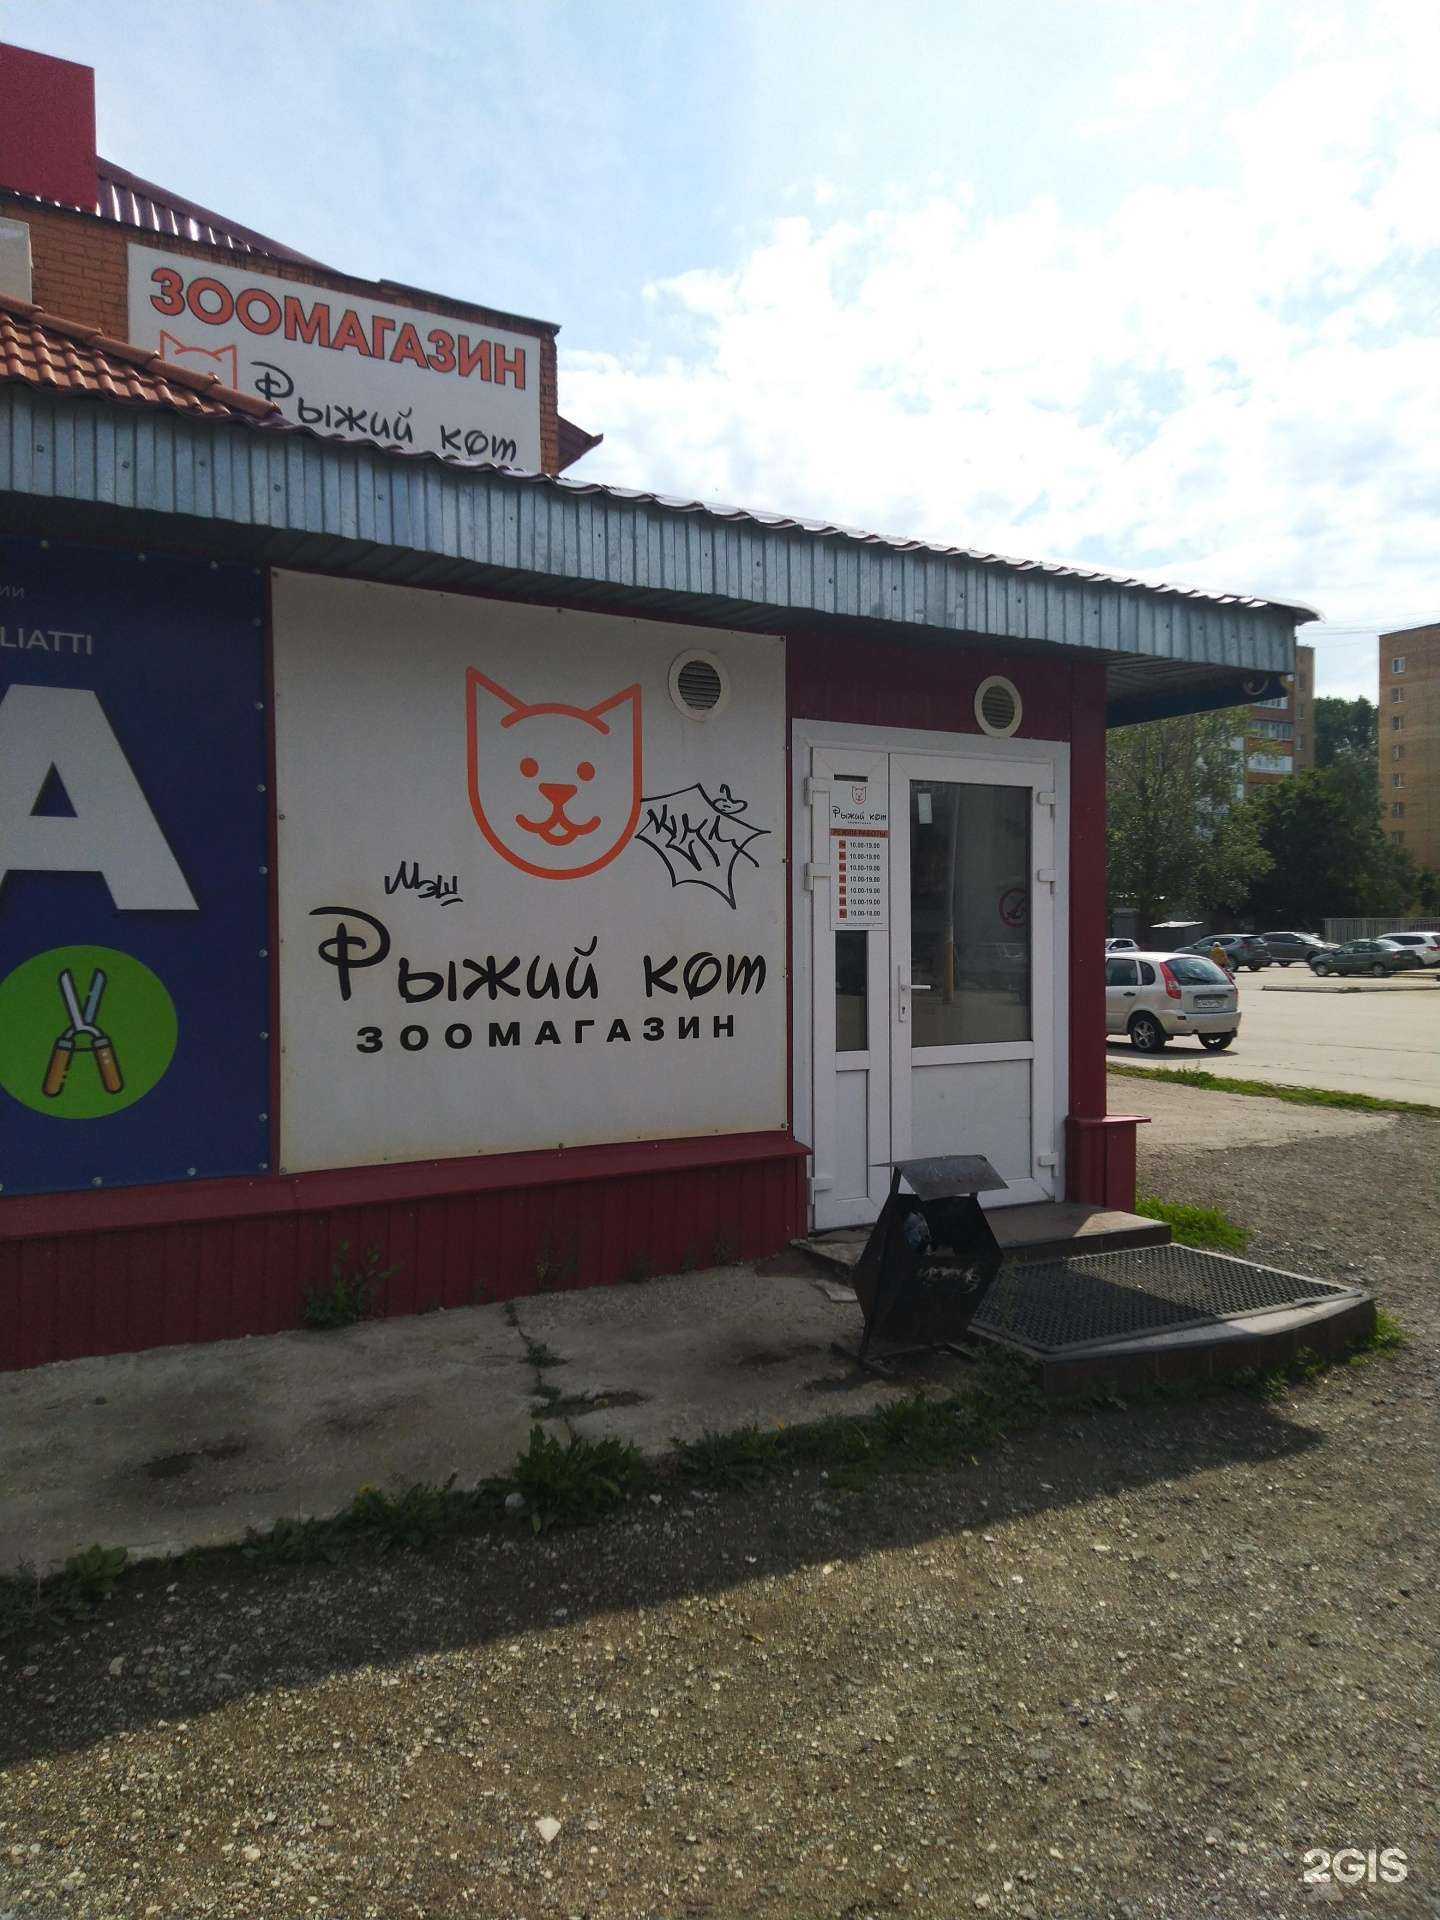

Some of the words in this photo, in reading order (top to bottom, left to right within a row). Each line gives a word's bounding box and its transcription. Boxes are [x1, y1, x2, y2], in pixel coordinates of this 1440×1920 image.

[150, 267, 527, 390] ЗООМАГАЗИН
[250, 361, 414, 444] Рыжий
[440, 424, 517, 462] кот
[832, 805, 865, 820] Рыжий
[869, 813, 887, 821] кот
[308, 906, 599, 1002] Рыжий
[643, 952, 767, 1000] кот
[356, 1014, 735, 1053] ЗООМАГАЗИН
